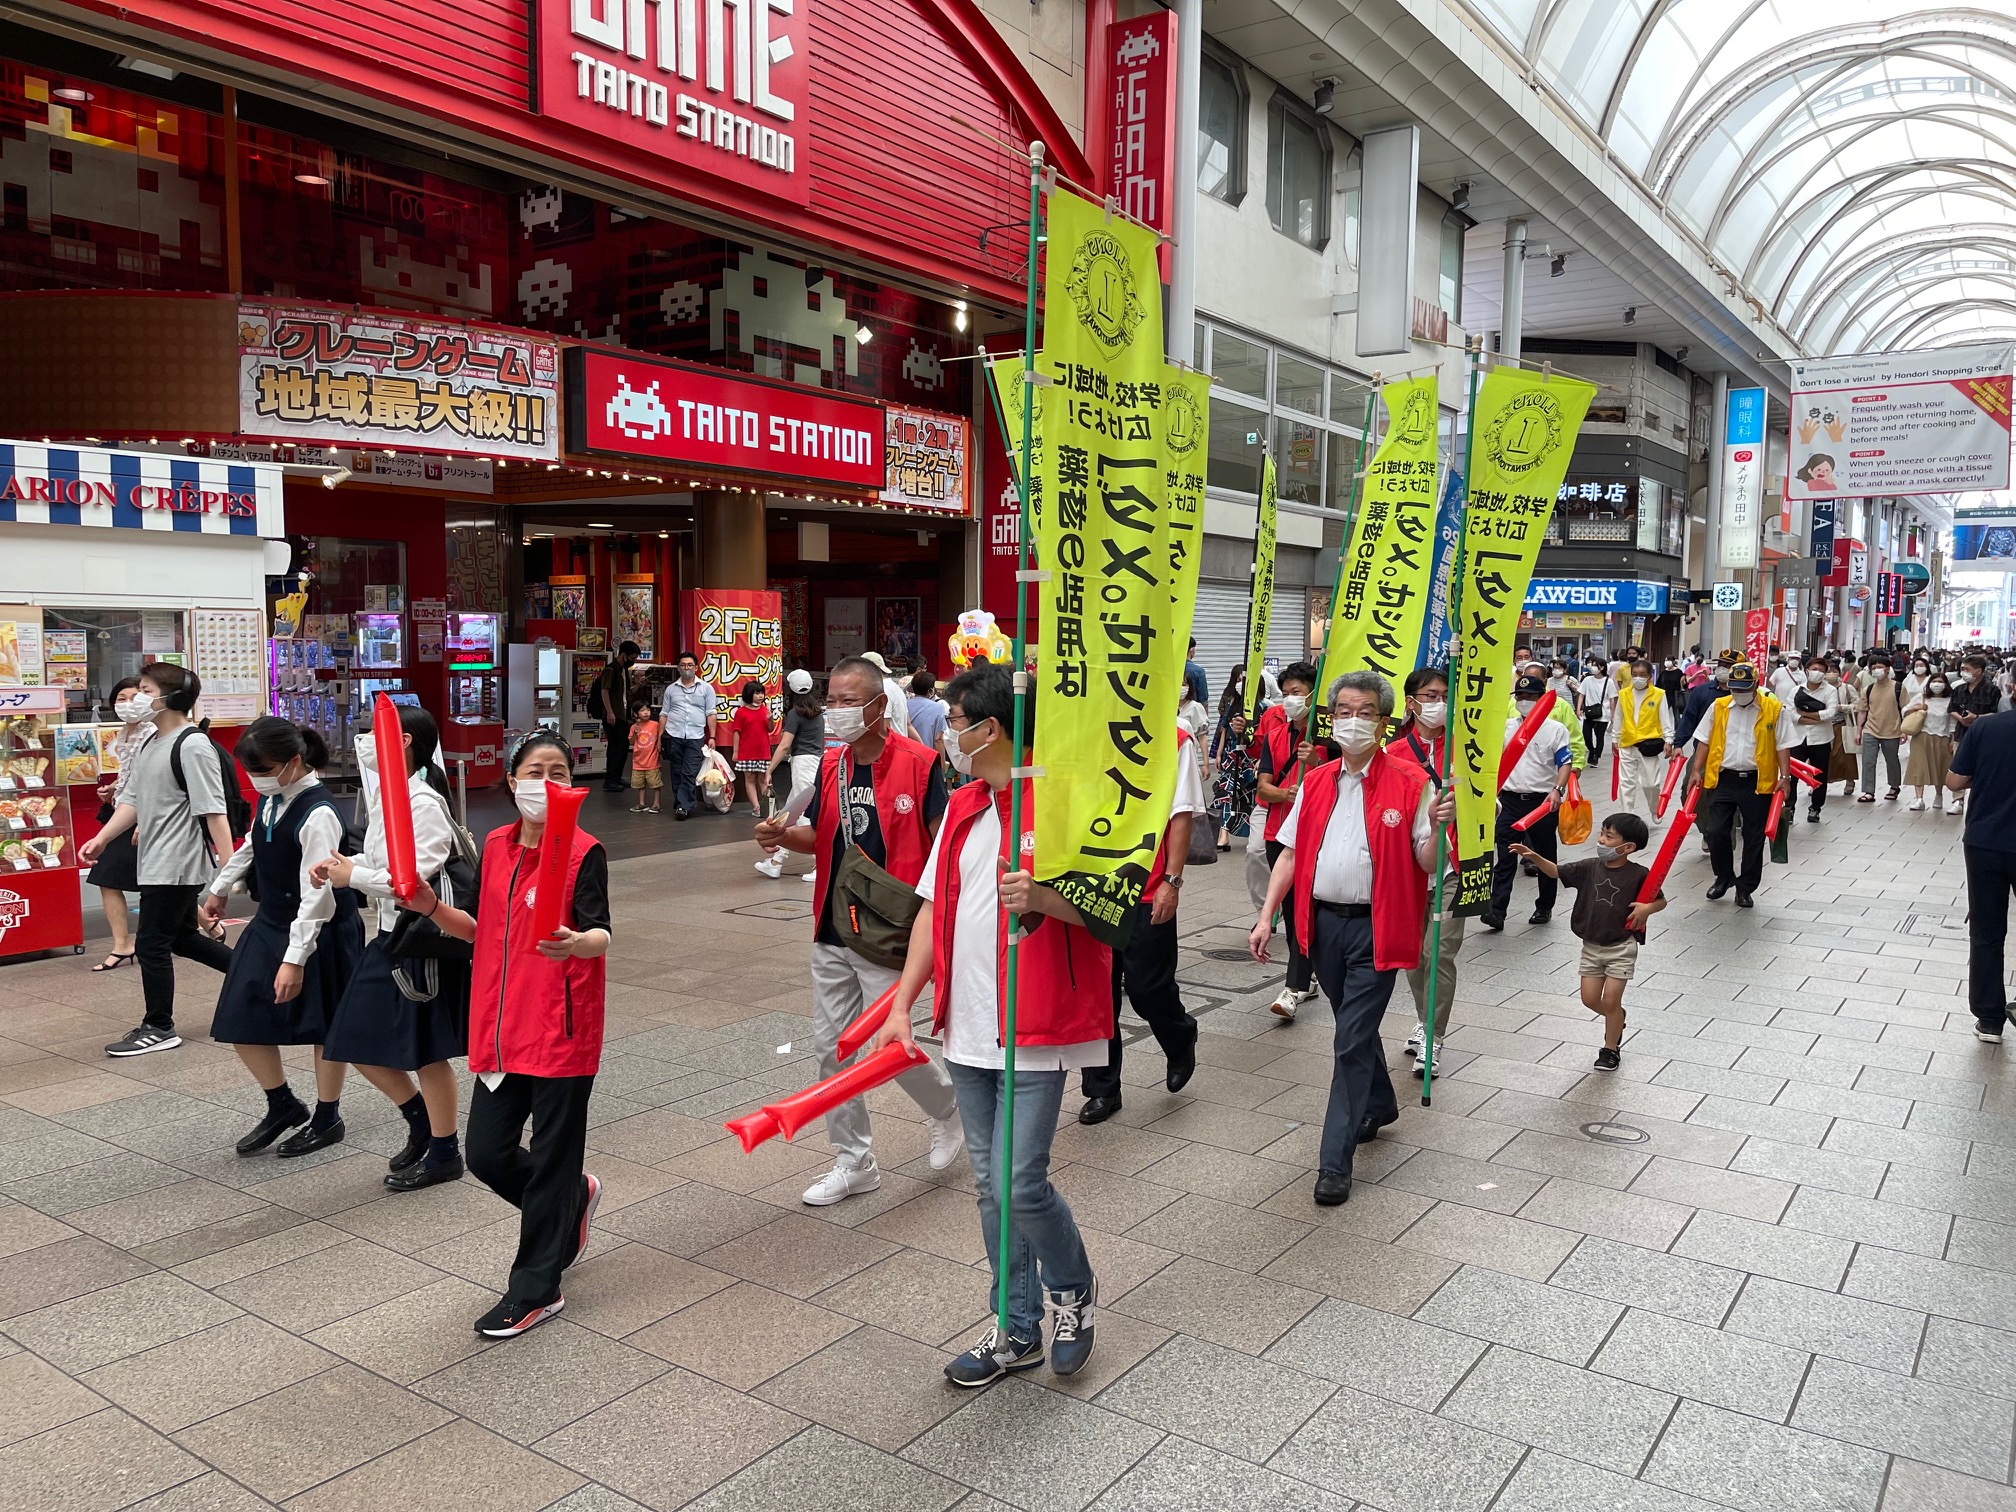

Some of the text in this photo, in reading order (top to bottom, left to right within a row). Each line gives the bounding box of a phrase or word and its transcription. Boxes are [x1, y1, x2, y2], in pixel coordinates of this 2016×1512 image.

[571, 51, 795, 174] TAITO STATION
[1113, 75, 1125, 158] TAITO
[357, 318, 380, 326] CRANE
[274, 319, 532, 387] クレーンゲーム
[1800, 379, 1822, 387] Don't
[1824, 377, 1841, 385] lose
[1852, 374, 1876, 382] virus!
[1881, 372, 1892, 381] by
[1894, 370, 1929, 379] Hondori
[1932, 367, 1973, 377] Shopping
[1975, 364, 2005, 373] Street.
[256, 365, 547, 447] 地域最大級!!
[1851, 408, 1977, 424] hands, upon returning home,
[1852, 400, 1944, 413] Frequently wash your
[677, 400, 872, 466] TAITO STATION
[1851, 426, 1878, 434] before
[1880, 424, 1897, 432] and
[1899, 422, 1921, 430] after
[1923, 420, 1957, 430] cooking
[1851, 433, 1908, 443] before meals!
[356, 456, 368, 470] 5F
[427, 462, 439, 477] 6F
[886, 444, 960, 477] クレーンゲーム
[1849, 471, 1868, 479] your
[1870, 468, 1899, 476] mouth
[1936, 465, 1955, 473] with
[1966, 463, 1992, 471] tissue
[1850, 460, 1874, 468] When
[1877, 459, 1892, 468] you
[1894, 457, 1925, 465] sneeze
[1939, 454, 1965, 463] cough
[1968, 453, 1992, 461] cover
[443, 467, 490, 480] プリントシール
[899, 465, 946, 501] 増台!!
[1917, 476, 1940, 484] mask
[1942, 475, 1985, 485] correctly!
[1, 476, 257, 518] ARION CRÊPES
[1734, 464, 1749, 526] メガネの田中
[992, 546, 1013, 556] TAITO
[1853, 556, 1864, 583] いとや
[699, 607, 782, 648] 2Fにも
[700, 652, 783, 686] クレーンゲ
